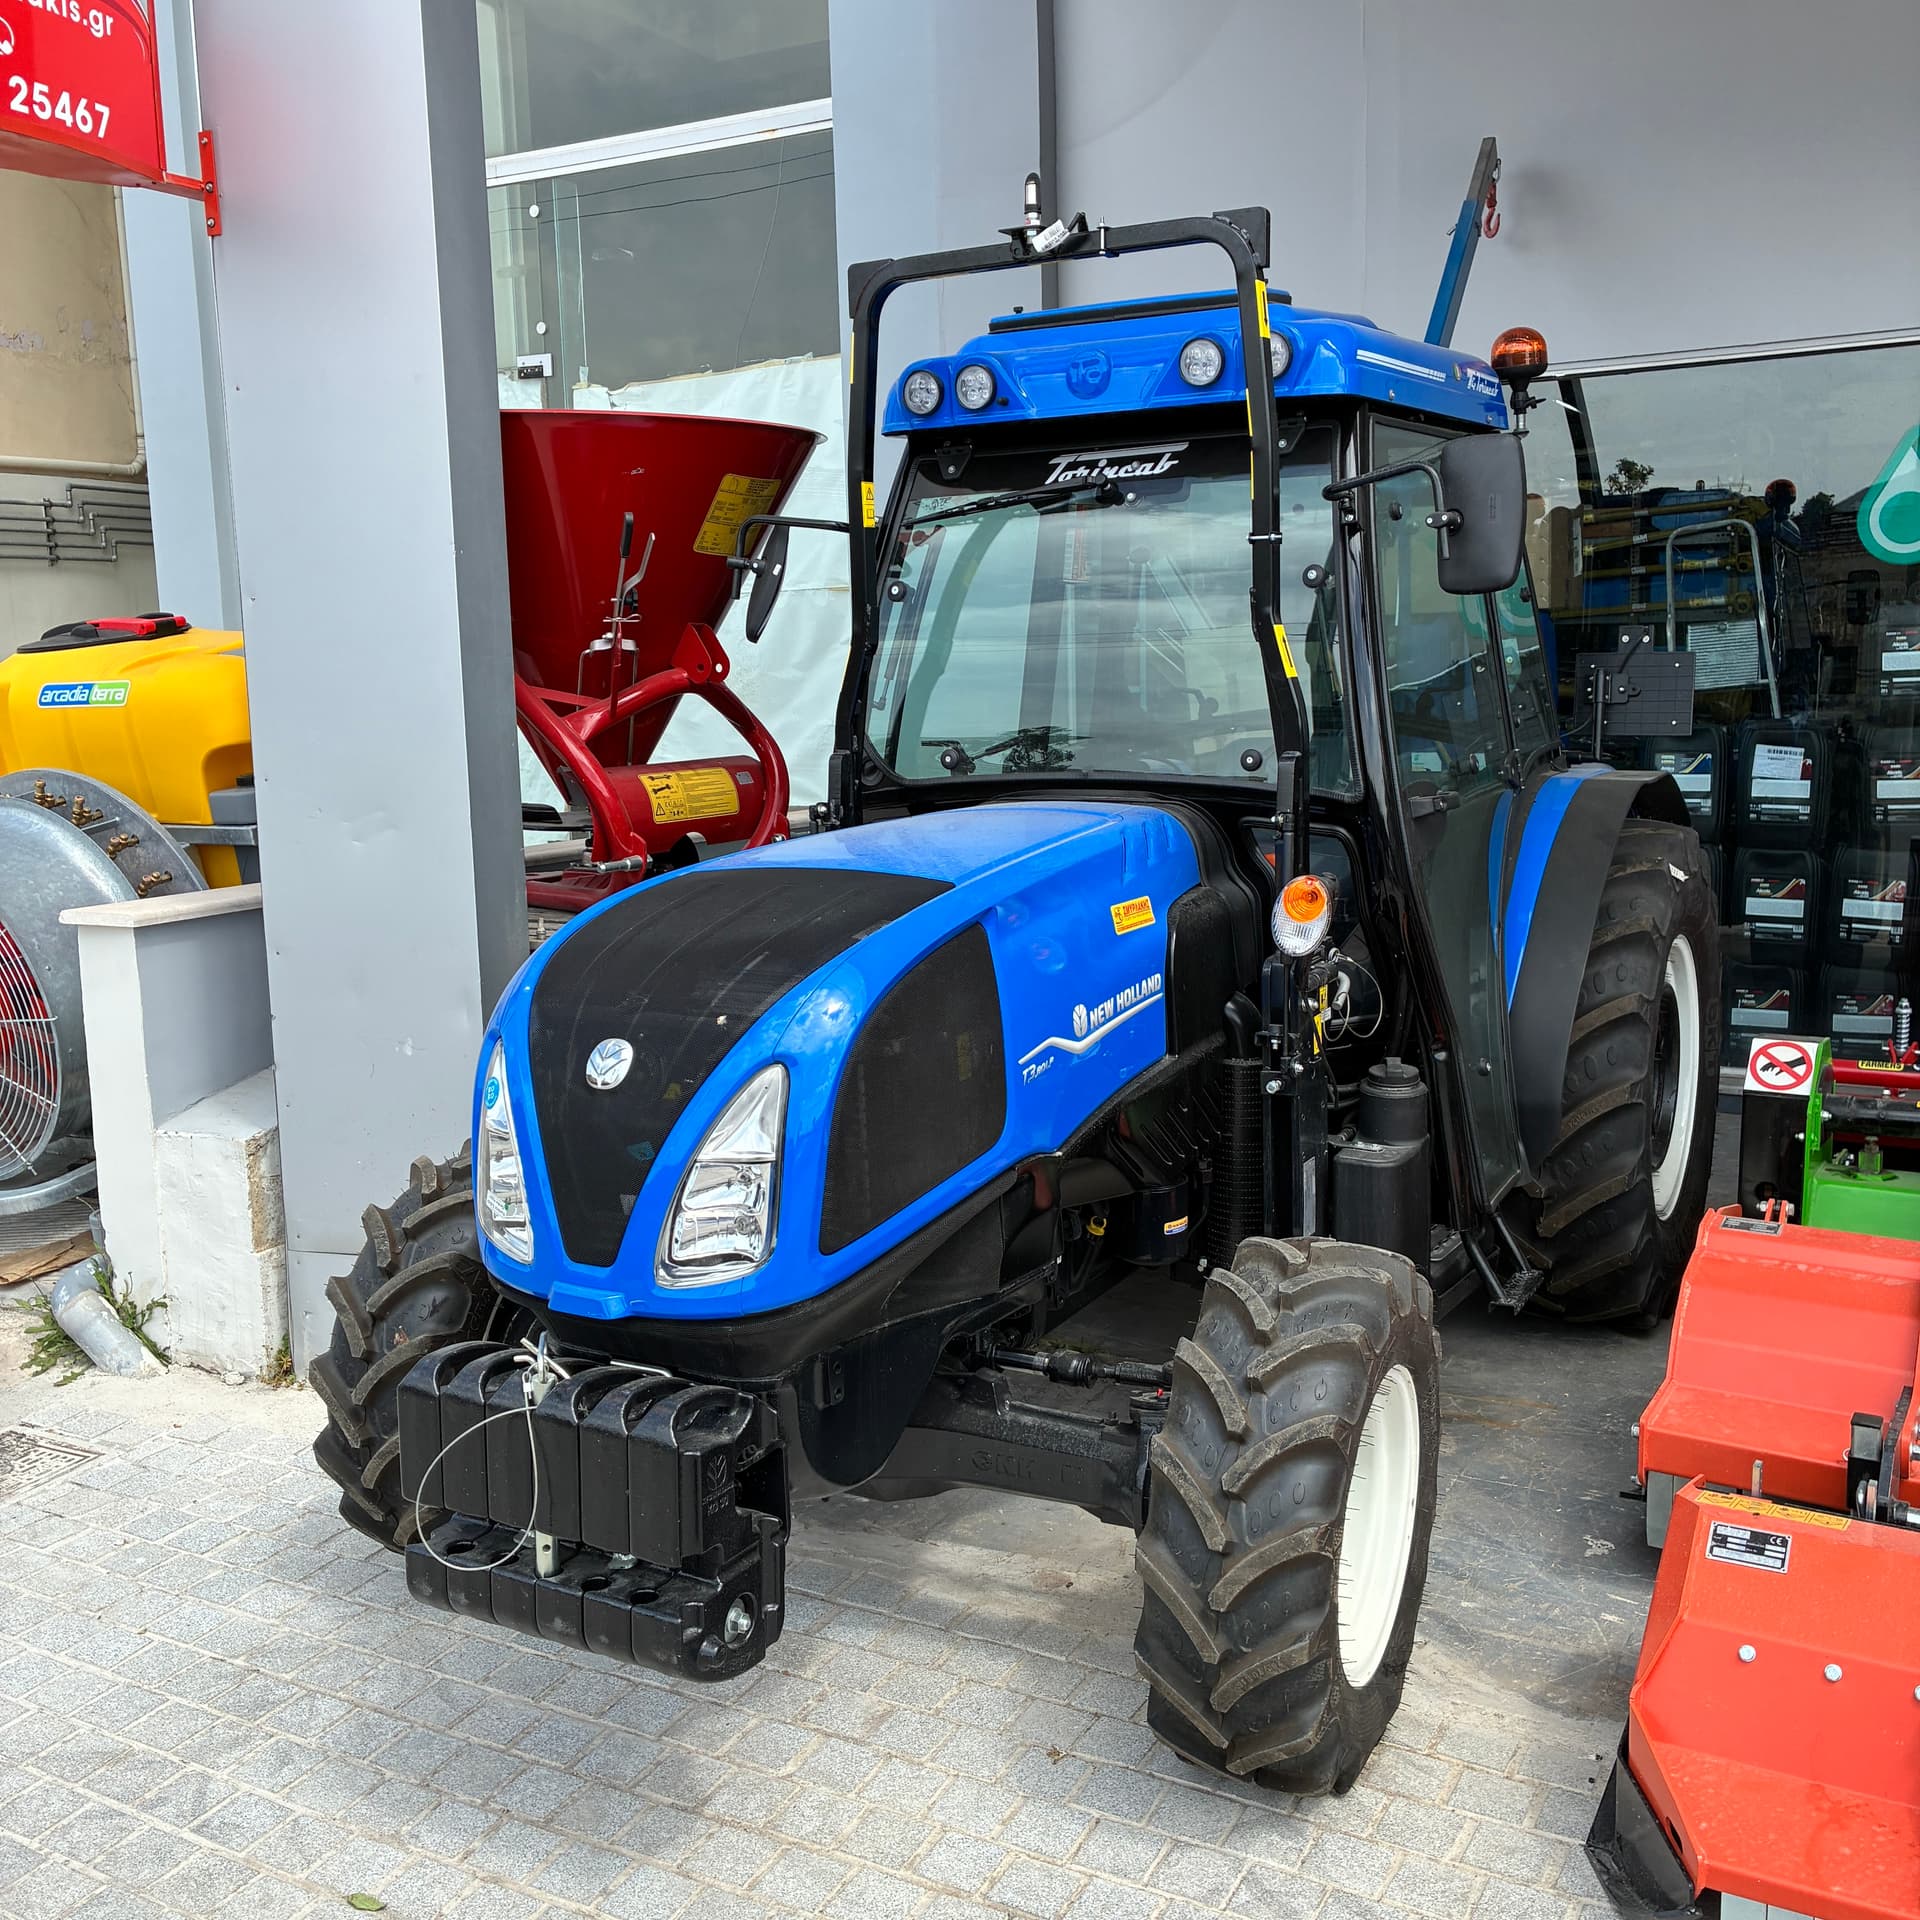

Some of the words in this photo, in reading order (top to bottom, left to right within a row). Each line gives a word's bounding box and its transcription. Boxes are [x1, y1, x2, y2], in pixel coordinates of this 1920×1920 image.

[8, 74, 111, 139] 25467
[41, 685, 90, 703] arcadia
[90, 684, 125, 702] terra
[1089, 997, 1114, 1030] NEW
[1116, 973, 1162, 1012] HOLLAND
